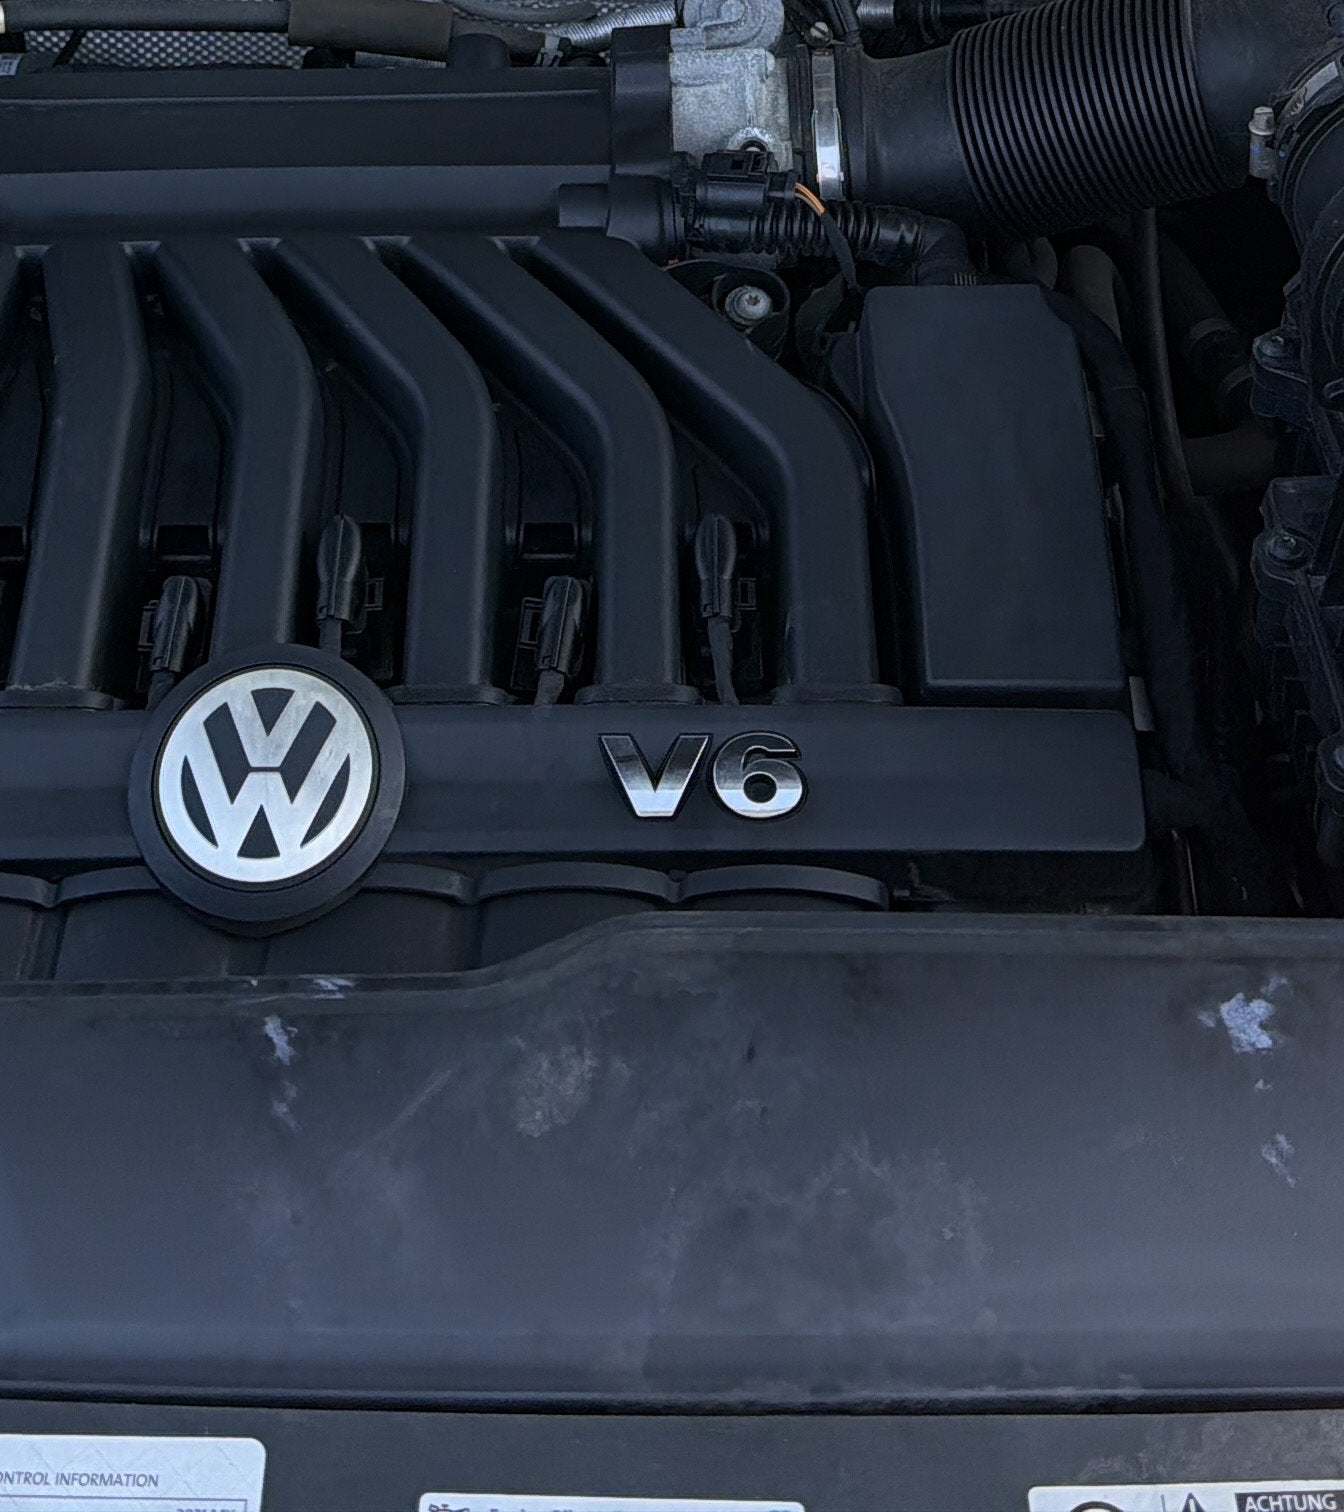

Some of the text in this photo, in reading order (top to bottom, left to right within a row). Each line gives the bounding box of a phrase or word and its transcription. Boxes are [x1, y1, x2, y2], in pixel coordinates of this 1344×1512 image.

[597, 731, 810, 821] V6
[55, 1473, 159, 1488] INFORMATION
[1244, 1492, 1337, 1512] ACHTUNG
